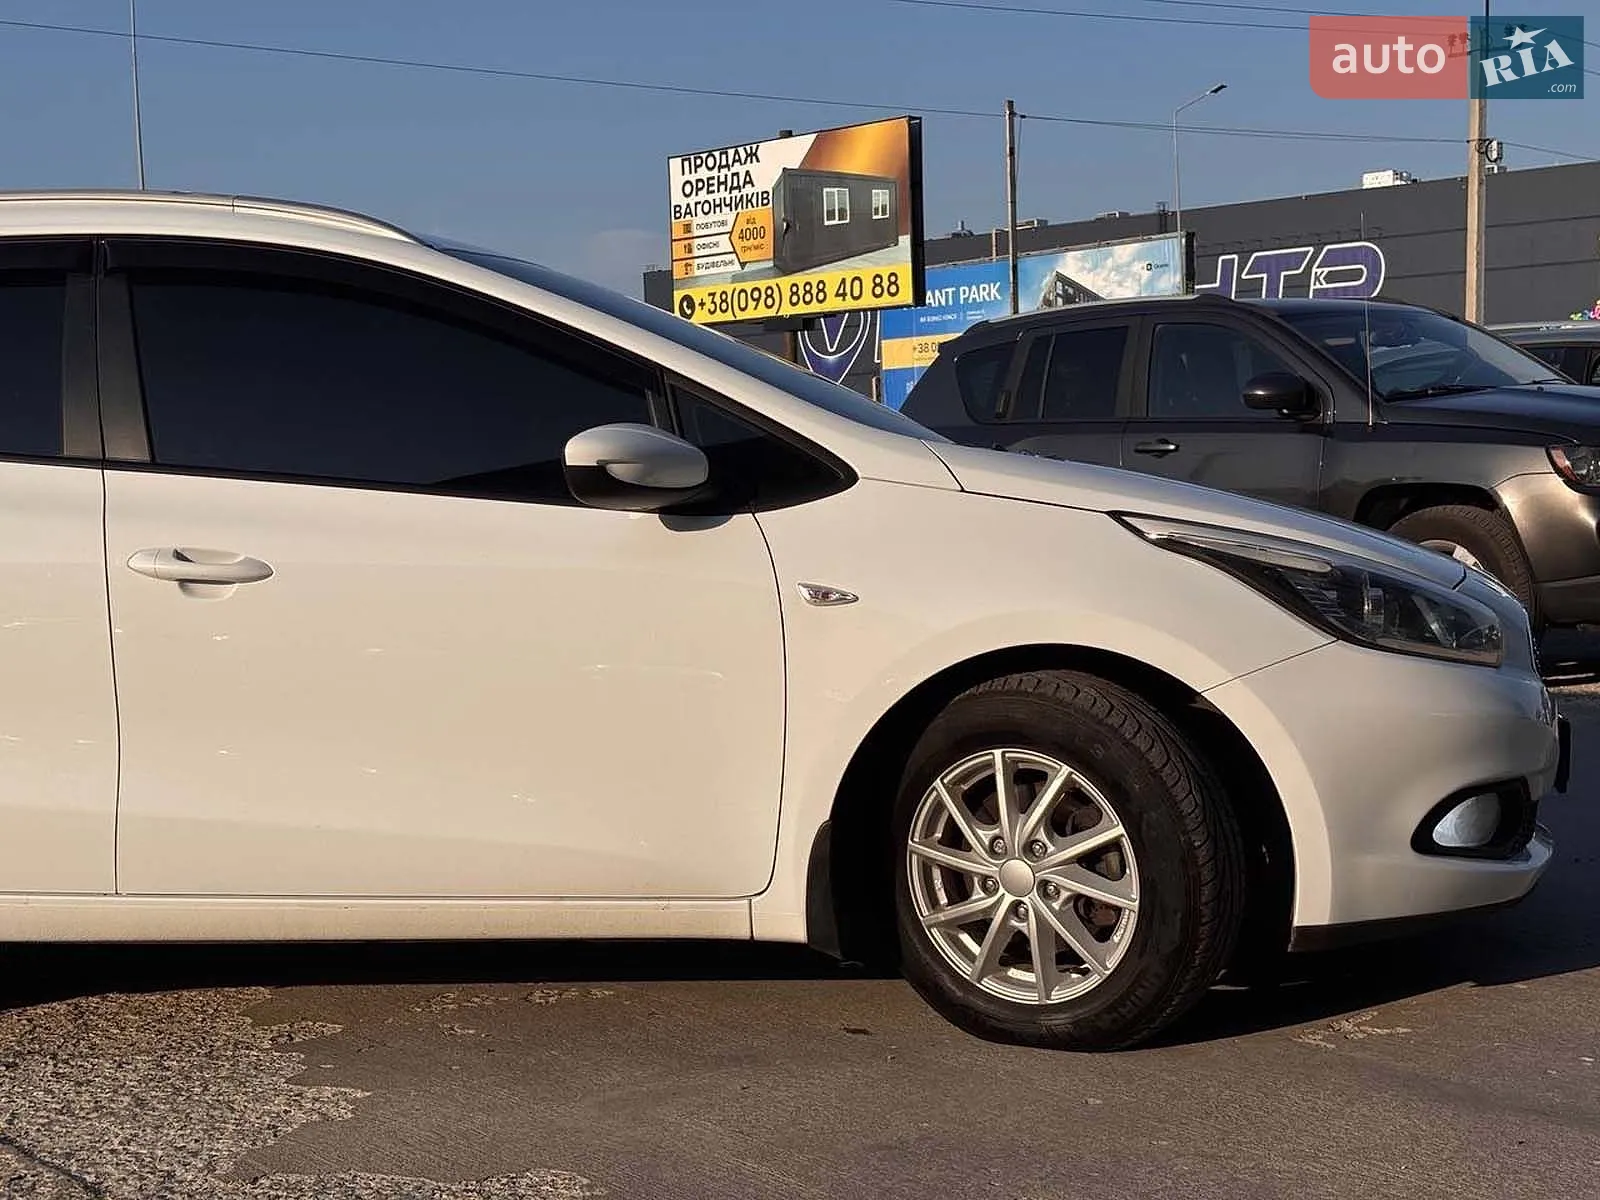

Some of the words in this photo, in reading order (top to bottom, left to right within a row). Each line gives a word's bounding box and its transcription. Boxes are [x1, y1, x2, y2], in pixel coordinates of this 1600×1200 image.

[681, 144, 760, 176] ПРОДАЖ
[682, 170, 755, 198] ОРЕНДА
[673, 190, 770, 220] ВАГОНЧИКІВ
[738, 226, 766, 242] 4000
[698, 283, 783, 319] +38(098)
[789, 280, 827, 307] 888
[834, 276, 863, 302] 40
[871, 271, 900, 299] 88
[925, 287, 956, 307] ANT
[959, 282, 1002, 304] PARK
